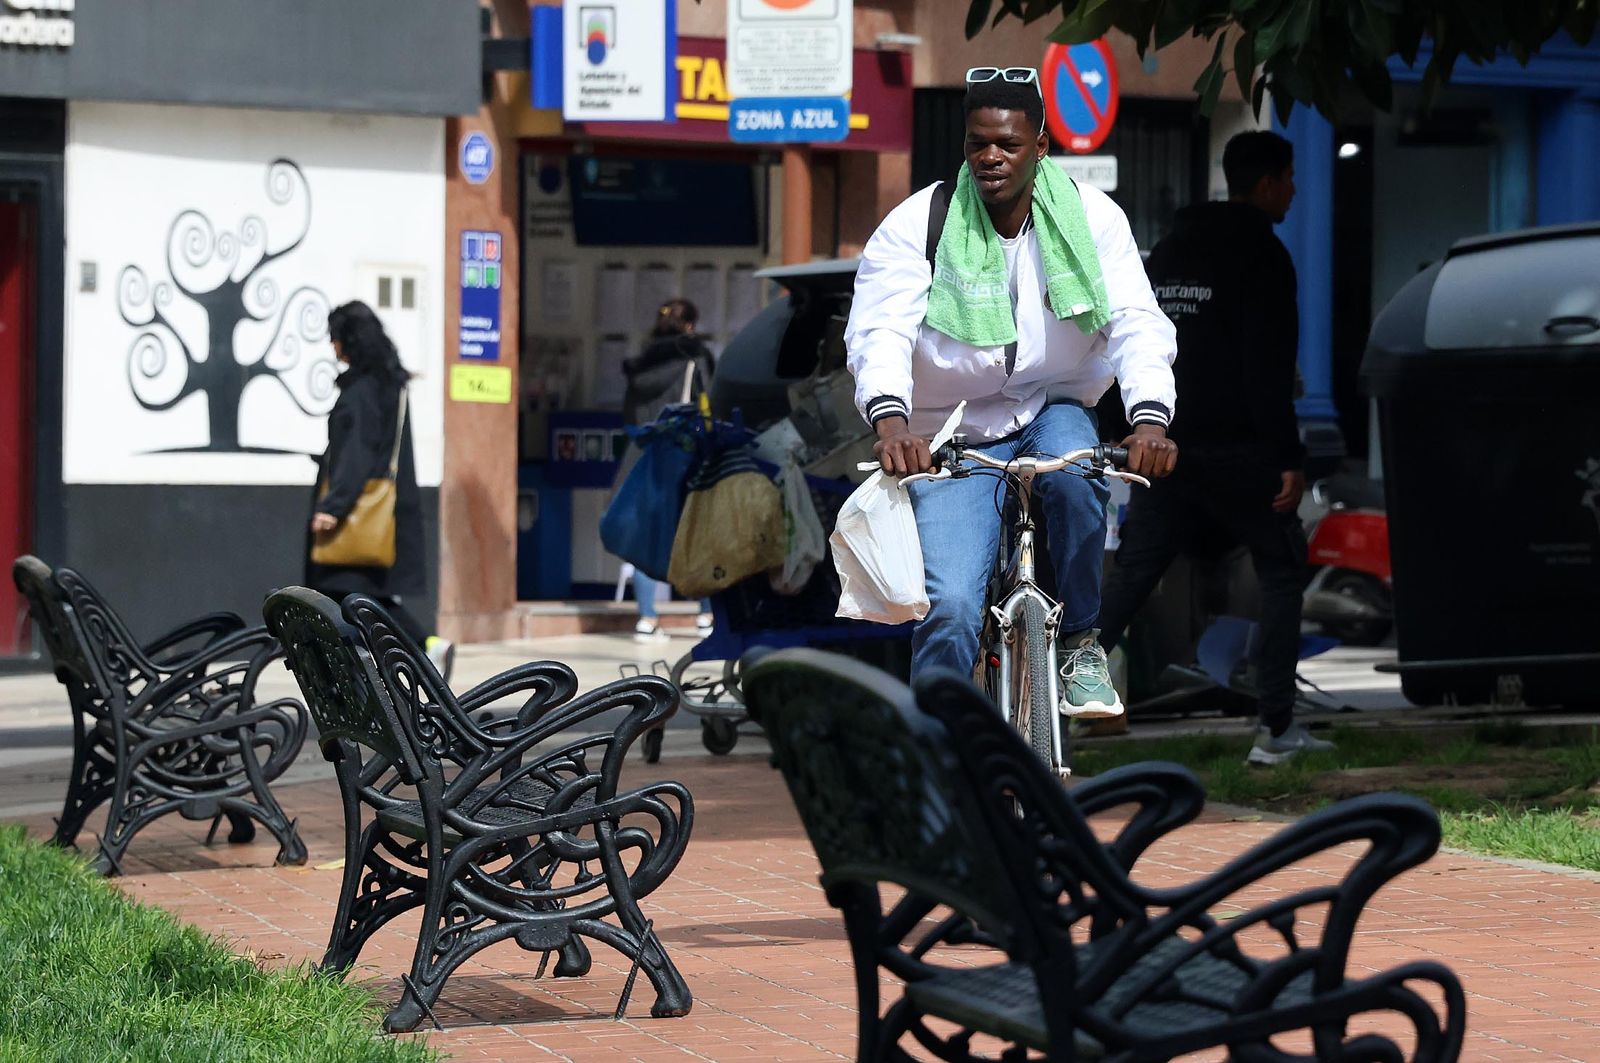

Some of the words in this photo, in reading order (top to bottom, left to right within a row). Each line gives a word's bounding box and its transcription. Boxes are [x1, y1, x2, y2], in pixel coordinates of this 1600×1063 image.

[735, 110, 785, 130] ZONA
[790, 109, 838, 128] AZUL
[1154, 284, 1212, 302] ruzcampo
